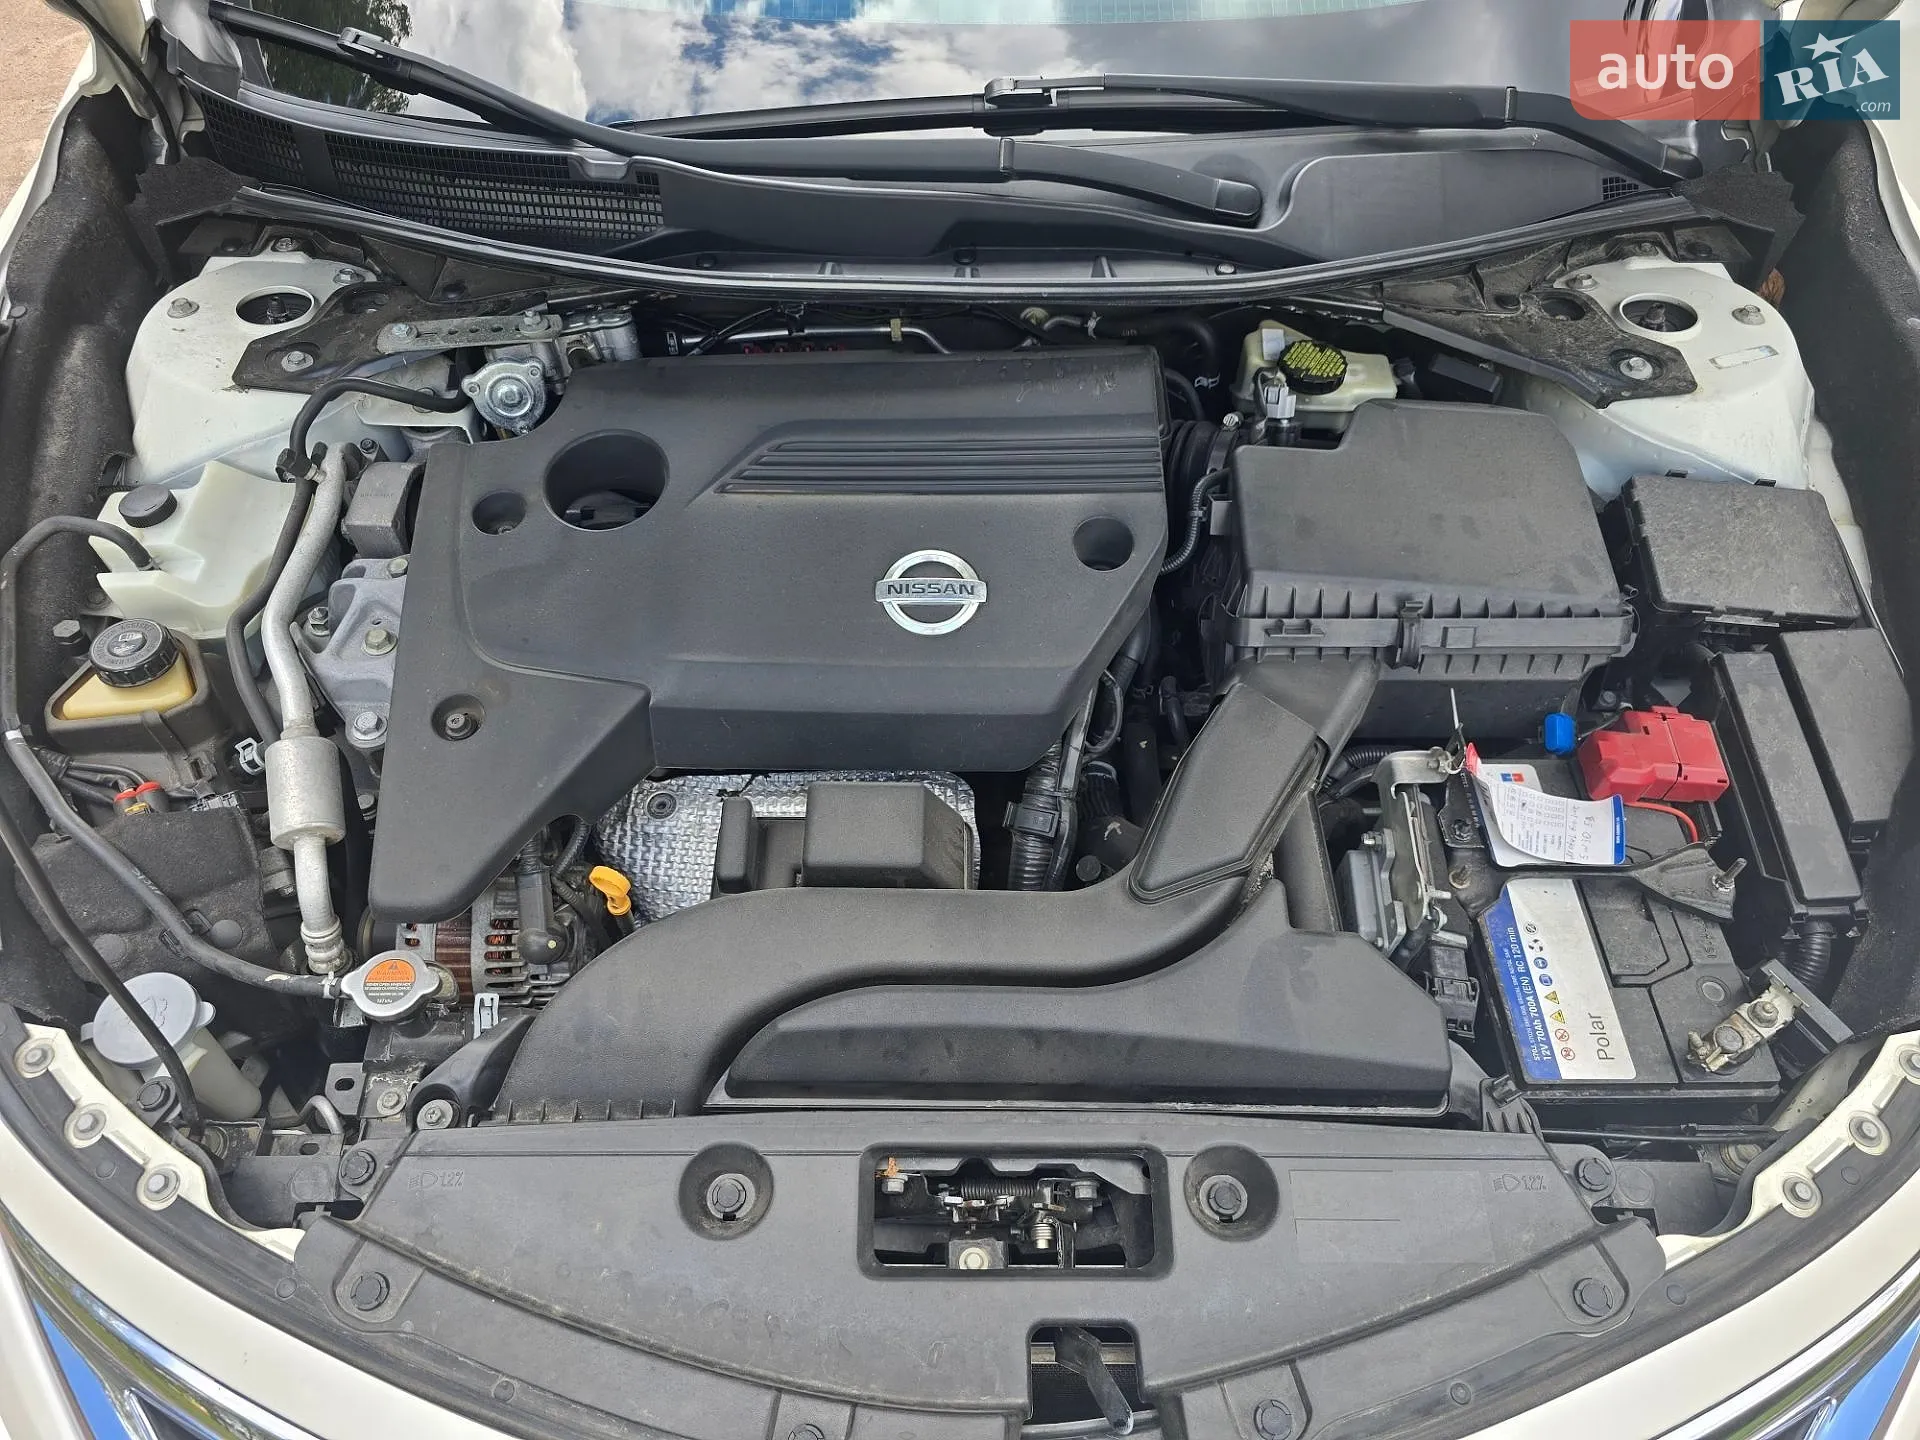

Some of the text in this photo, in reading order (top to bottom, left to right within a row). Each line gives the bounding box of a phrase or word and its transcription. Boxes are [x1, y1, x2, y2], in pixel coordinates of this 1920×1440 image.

[887, 583, 975, 595] NISSAN
[1507, 927, 1517, 943] min
[1510, 943, 1522, 958] 120
[1515, 960, 1526, 973] RC
[1519, 976, 1534, 994] (EN)
[1525, 996, 1539, 1018] 700A
[1533, 1019, 1547, 1042] 70Ah
[1588, 1012, 1615, 1060] Polar
[1540, 1043, 1553, 1061] 12V
